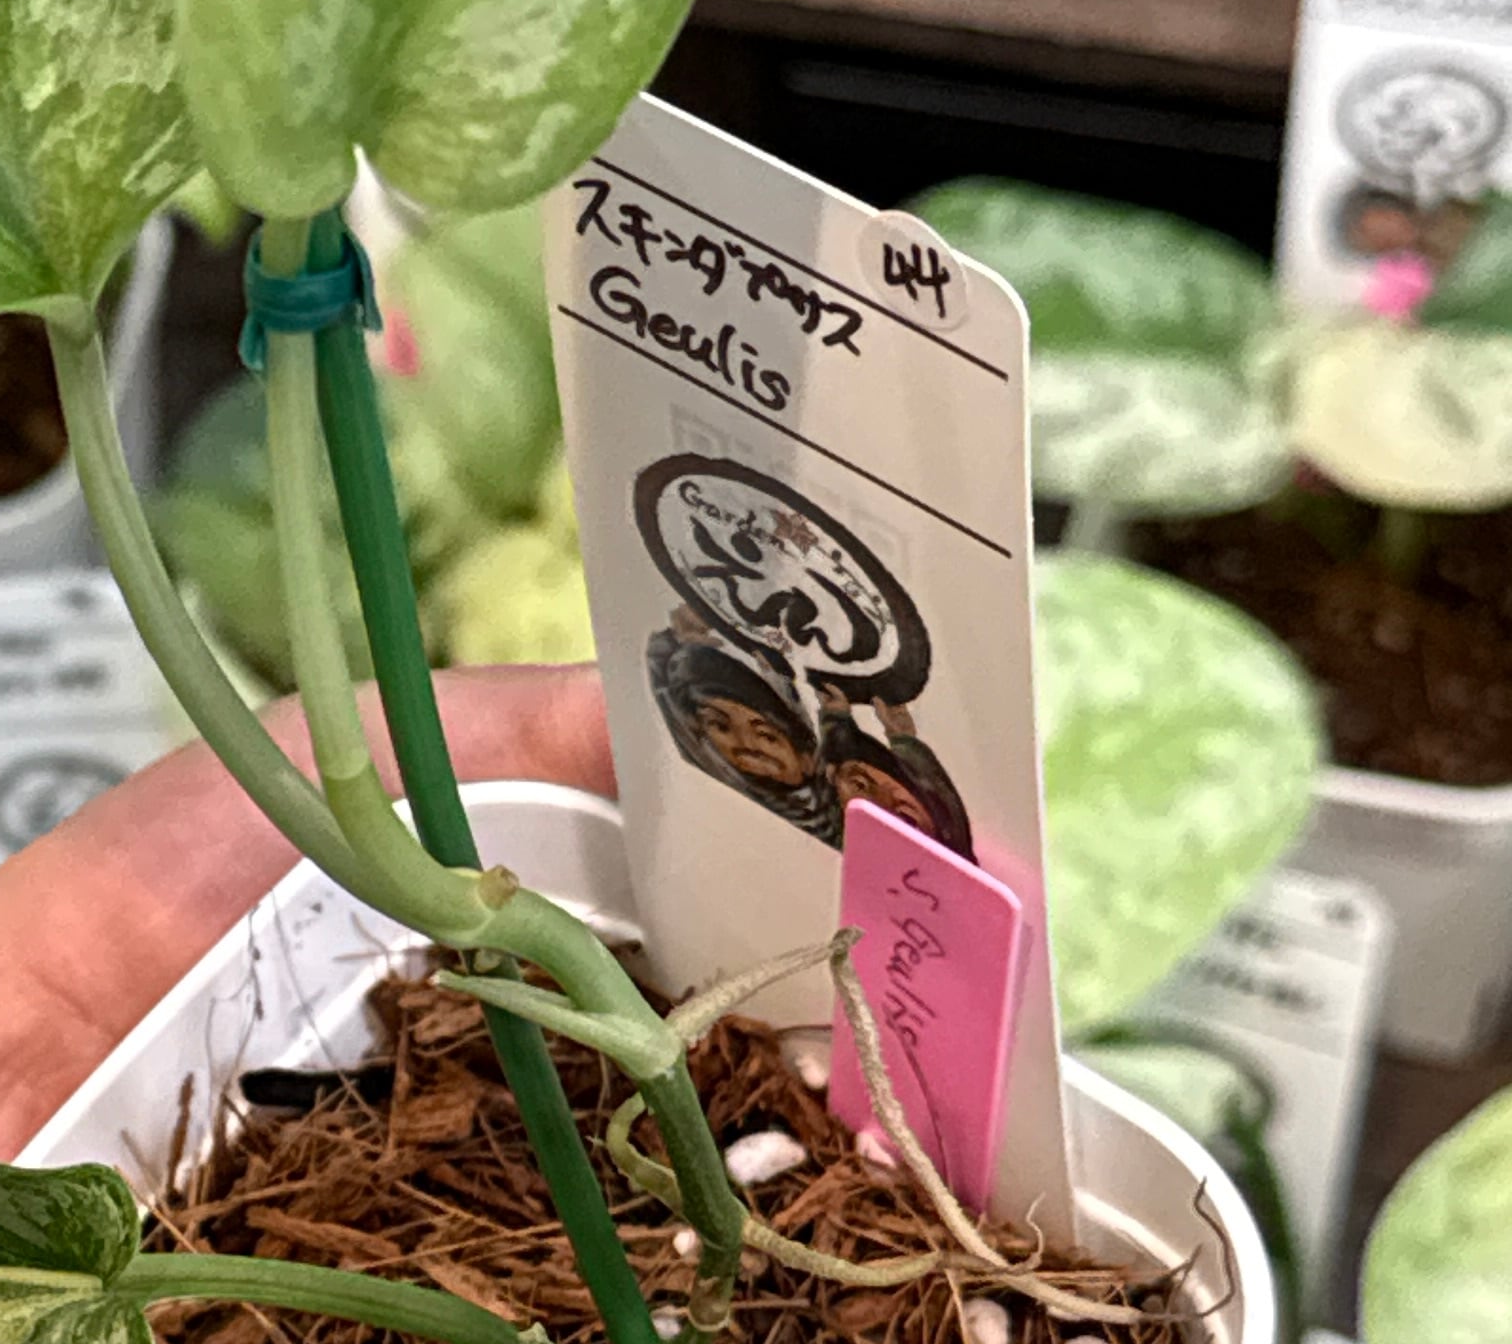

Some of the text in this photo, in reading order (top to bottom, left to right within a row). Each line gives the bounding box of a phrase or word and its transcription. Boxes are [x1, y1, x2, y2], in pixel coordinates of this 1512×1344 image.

[882, 242, 951, 319] 44
[589, 265, 790, 411] Geulis
[678, 480, 791, 556] Garden
[883, 916, 946, 1048] Geulis
